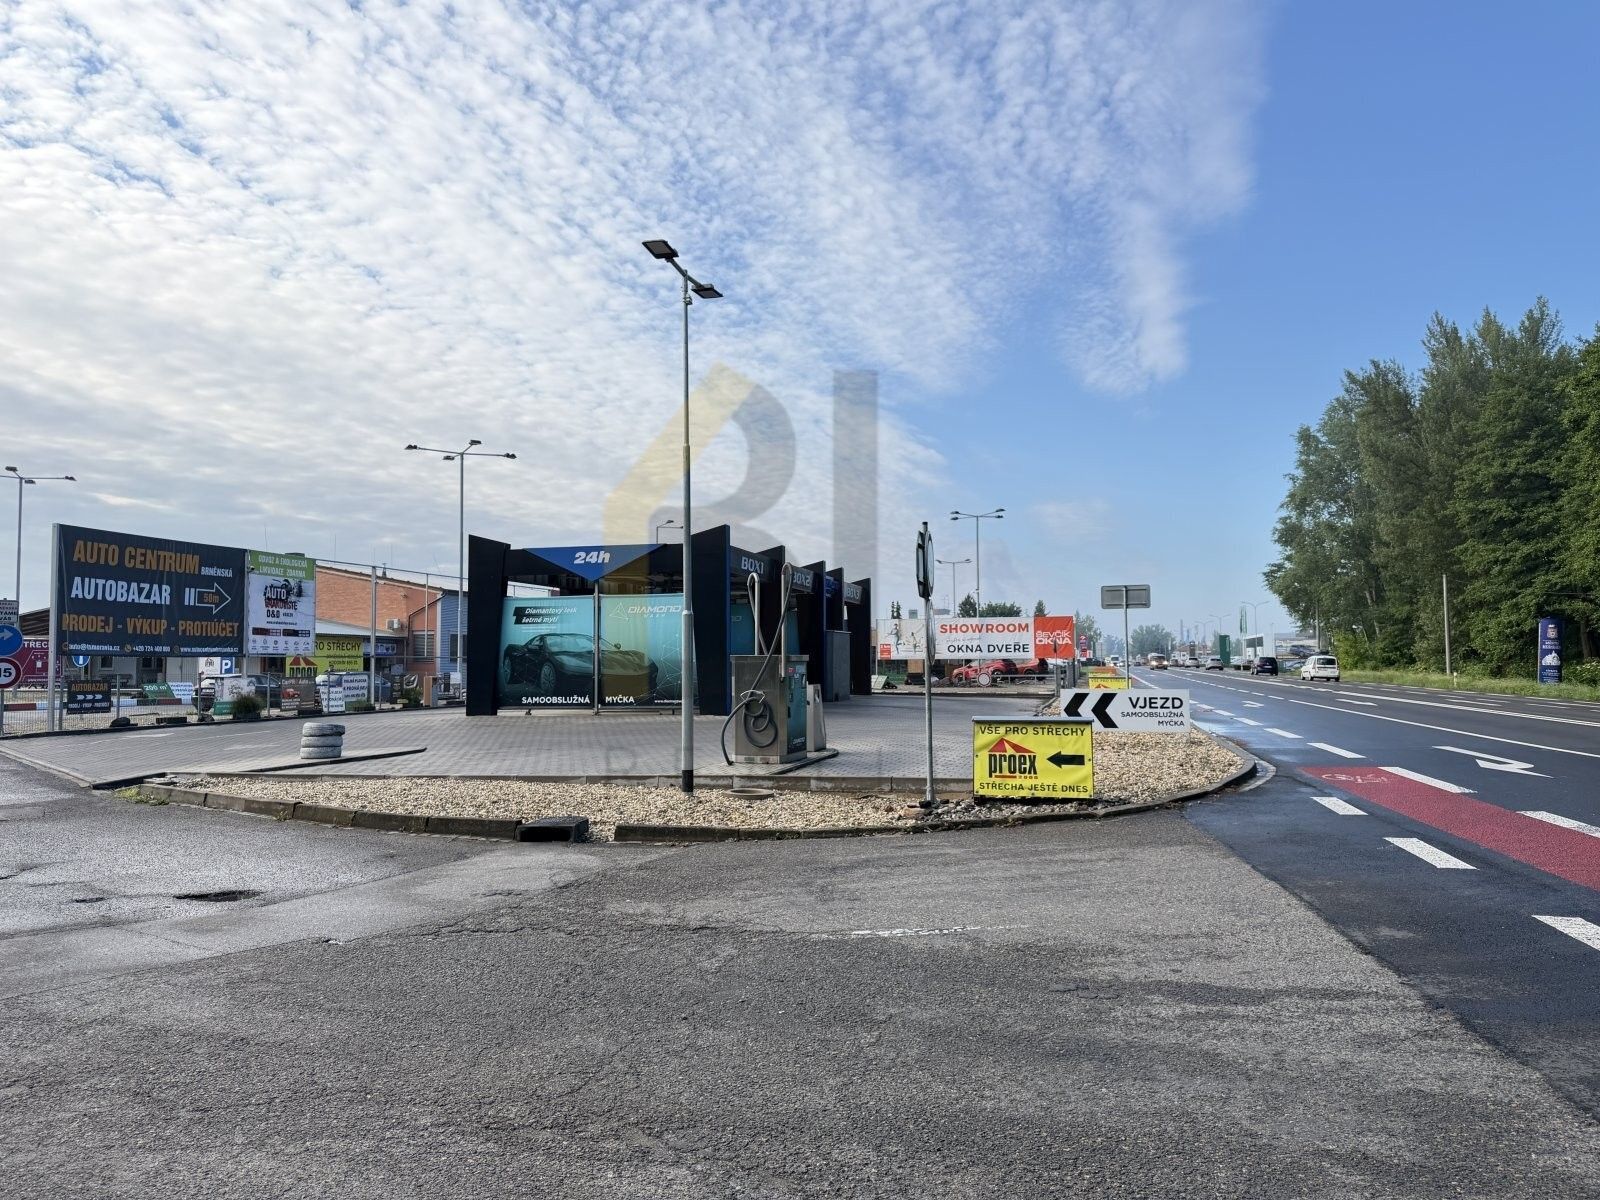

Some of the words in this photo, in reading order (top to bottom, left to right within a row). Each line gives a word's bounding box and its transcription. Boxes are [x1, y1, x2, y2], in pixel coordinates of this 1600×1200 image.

[73, 540, 119, 566] AUTO
[124, 546, 200, 575] CENTRUM
[201, 566, 233, 578] BRNĚNSKÁ
[573, 551, 611, 564] 24h
[70, 576, 171, 605] AUTOBAZAR
[203, 593, 219, 604] 50m
[266, 587, 287, 600] AUTO
[627, 605, 682, 614] DIAMOND
[62, 613, 114, 633] PRODEJ
[127, 614, 167, 635] VÝKUP
[178, 618, 240, 637] PROTIÚČET
[939, 623, 1029, 634] SHOWROOM
[1035, 630, 1071, 638] ŠEVČÍK
[327, 639, 361, 652] STŘECHY
[947, 643, 983, 653] OKNA
[987, 641, 1030, 653] DVEŘE
[1035, 637, 1072, 645] OKNA
[71, 683, 108, 692] AUTOBAZAR
[521, 694, 591, 704] SAMOOBSLUŽNÁ
[605, 694, 635, 704] MYČKA
[1128, 696, 1184, 710] VJEZD
[1120, 710, 1185, 718] SAMOOBSLUŽNÁ
[1157, 718, 1185, 727] MYČKA
[979, 724, 1000, 735] VŠE
[1005, 726, 1028, 736] PRO
[1033, 724, 1086, 737] STŘECHY
[988, 753, 1038, 778] proex
[979, 780, 1024, 791] STŘECHA
[1027, 782, 1058, 792] JEŠTĚ
[1061, 784, 1088, 794] DNES
